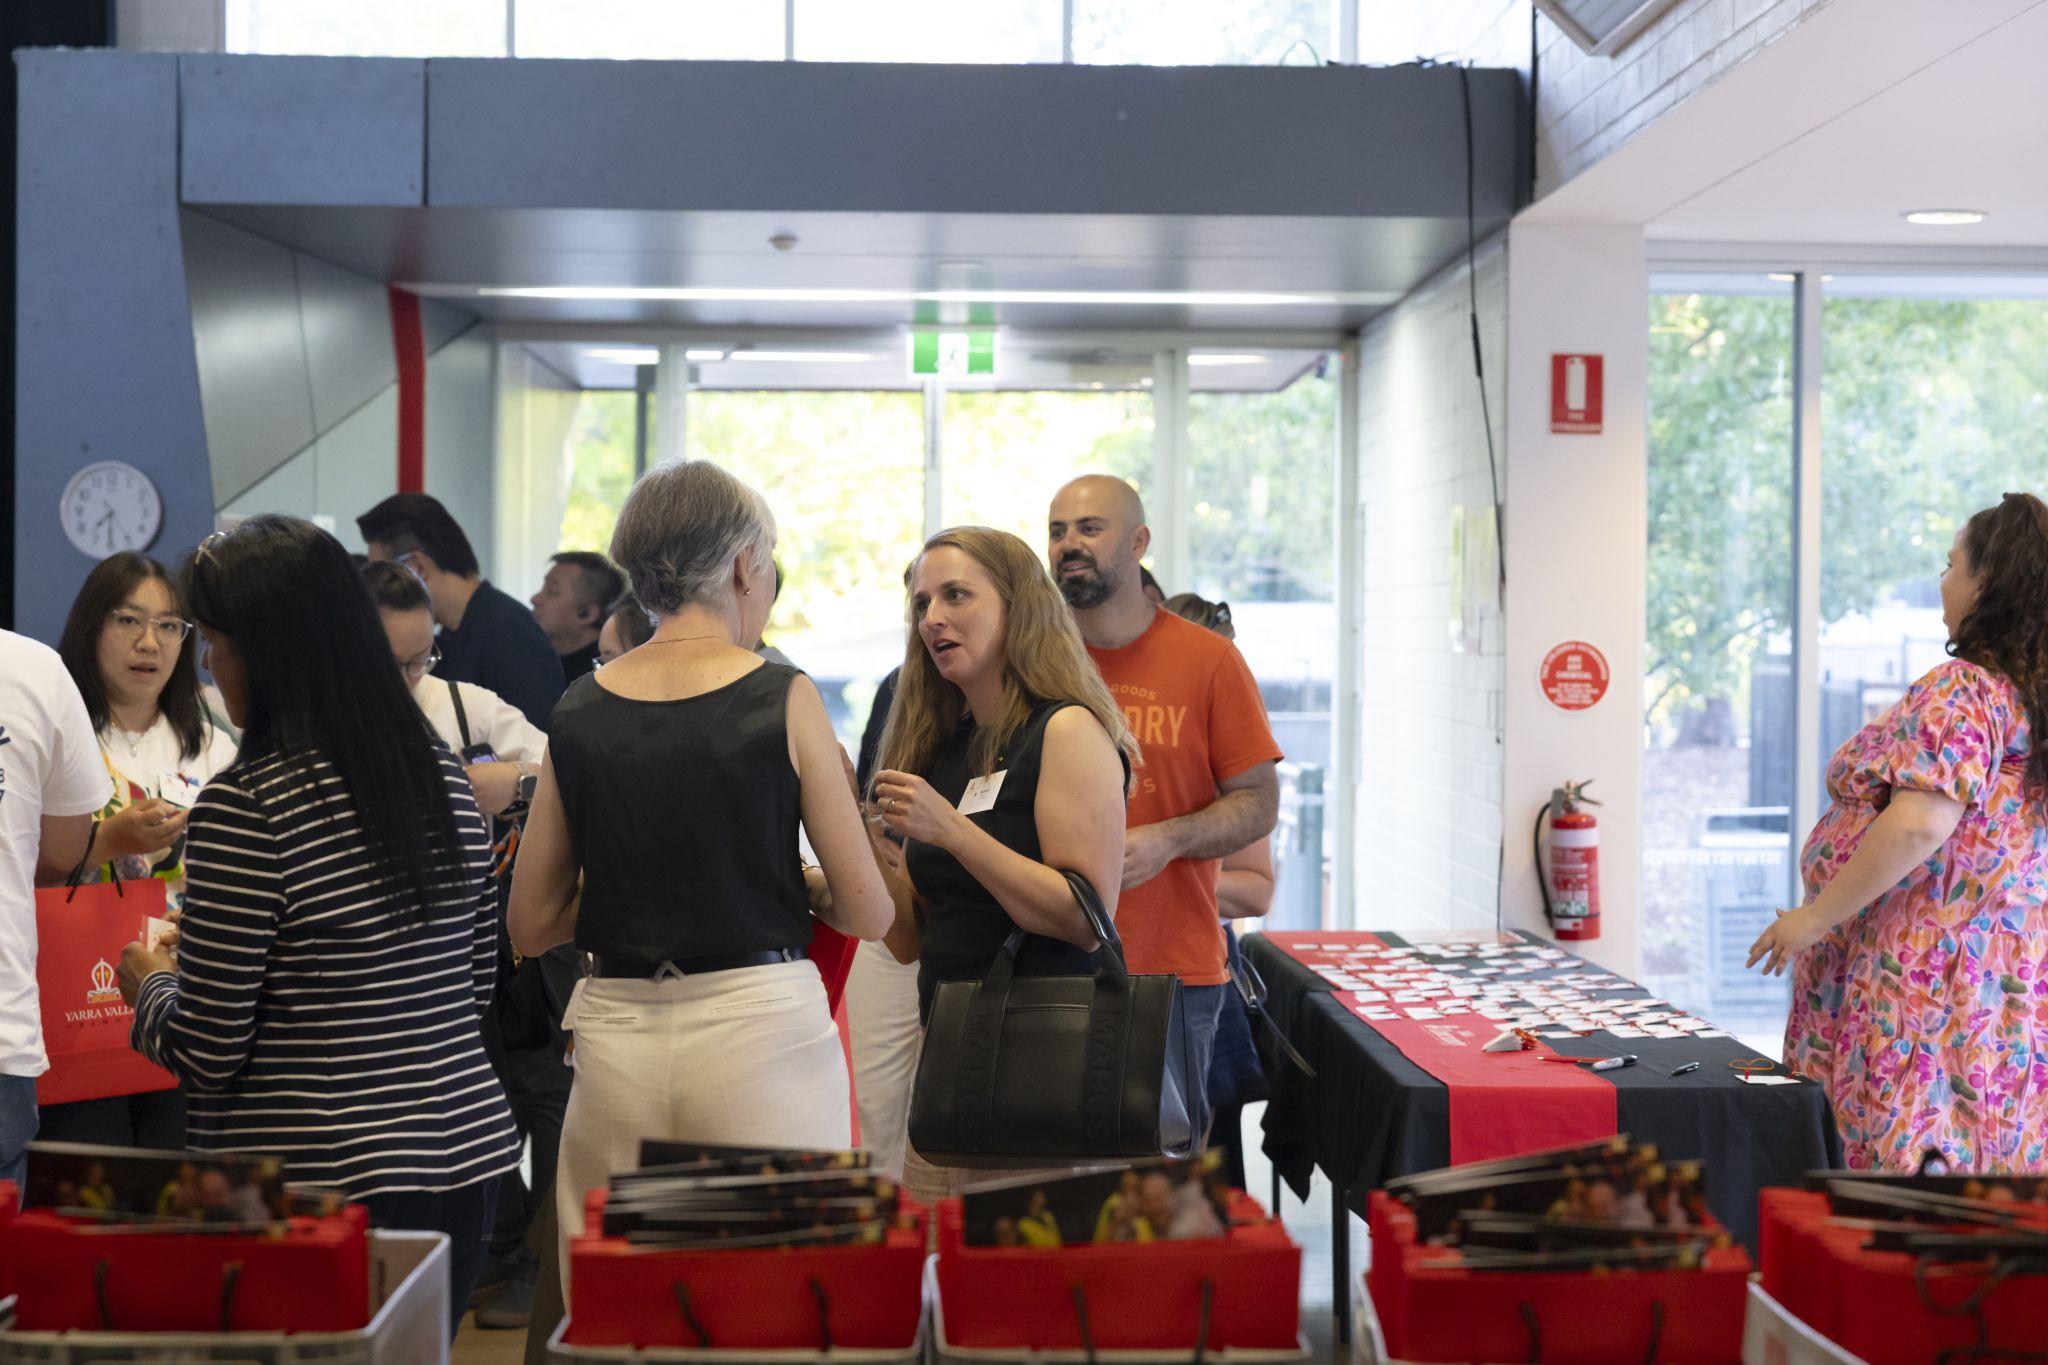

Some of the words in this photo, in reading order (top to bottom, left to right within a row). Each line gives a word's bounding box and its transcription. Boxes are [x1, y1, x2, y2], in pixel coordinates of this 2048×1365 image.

[1110, 683, 1157, 701] GOODS
[1124, 705, 1188, 748] DRY
[65, 1008, 103, 1022] YARRA
[104, 1005, 135, 1017] VALL
